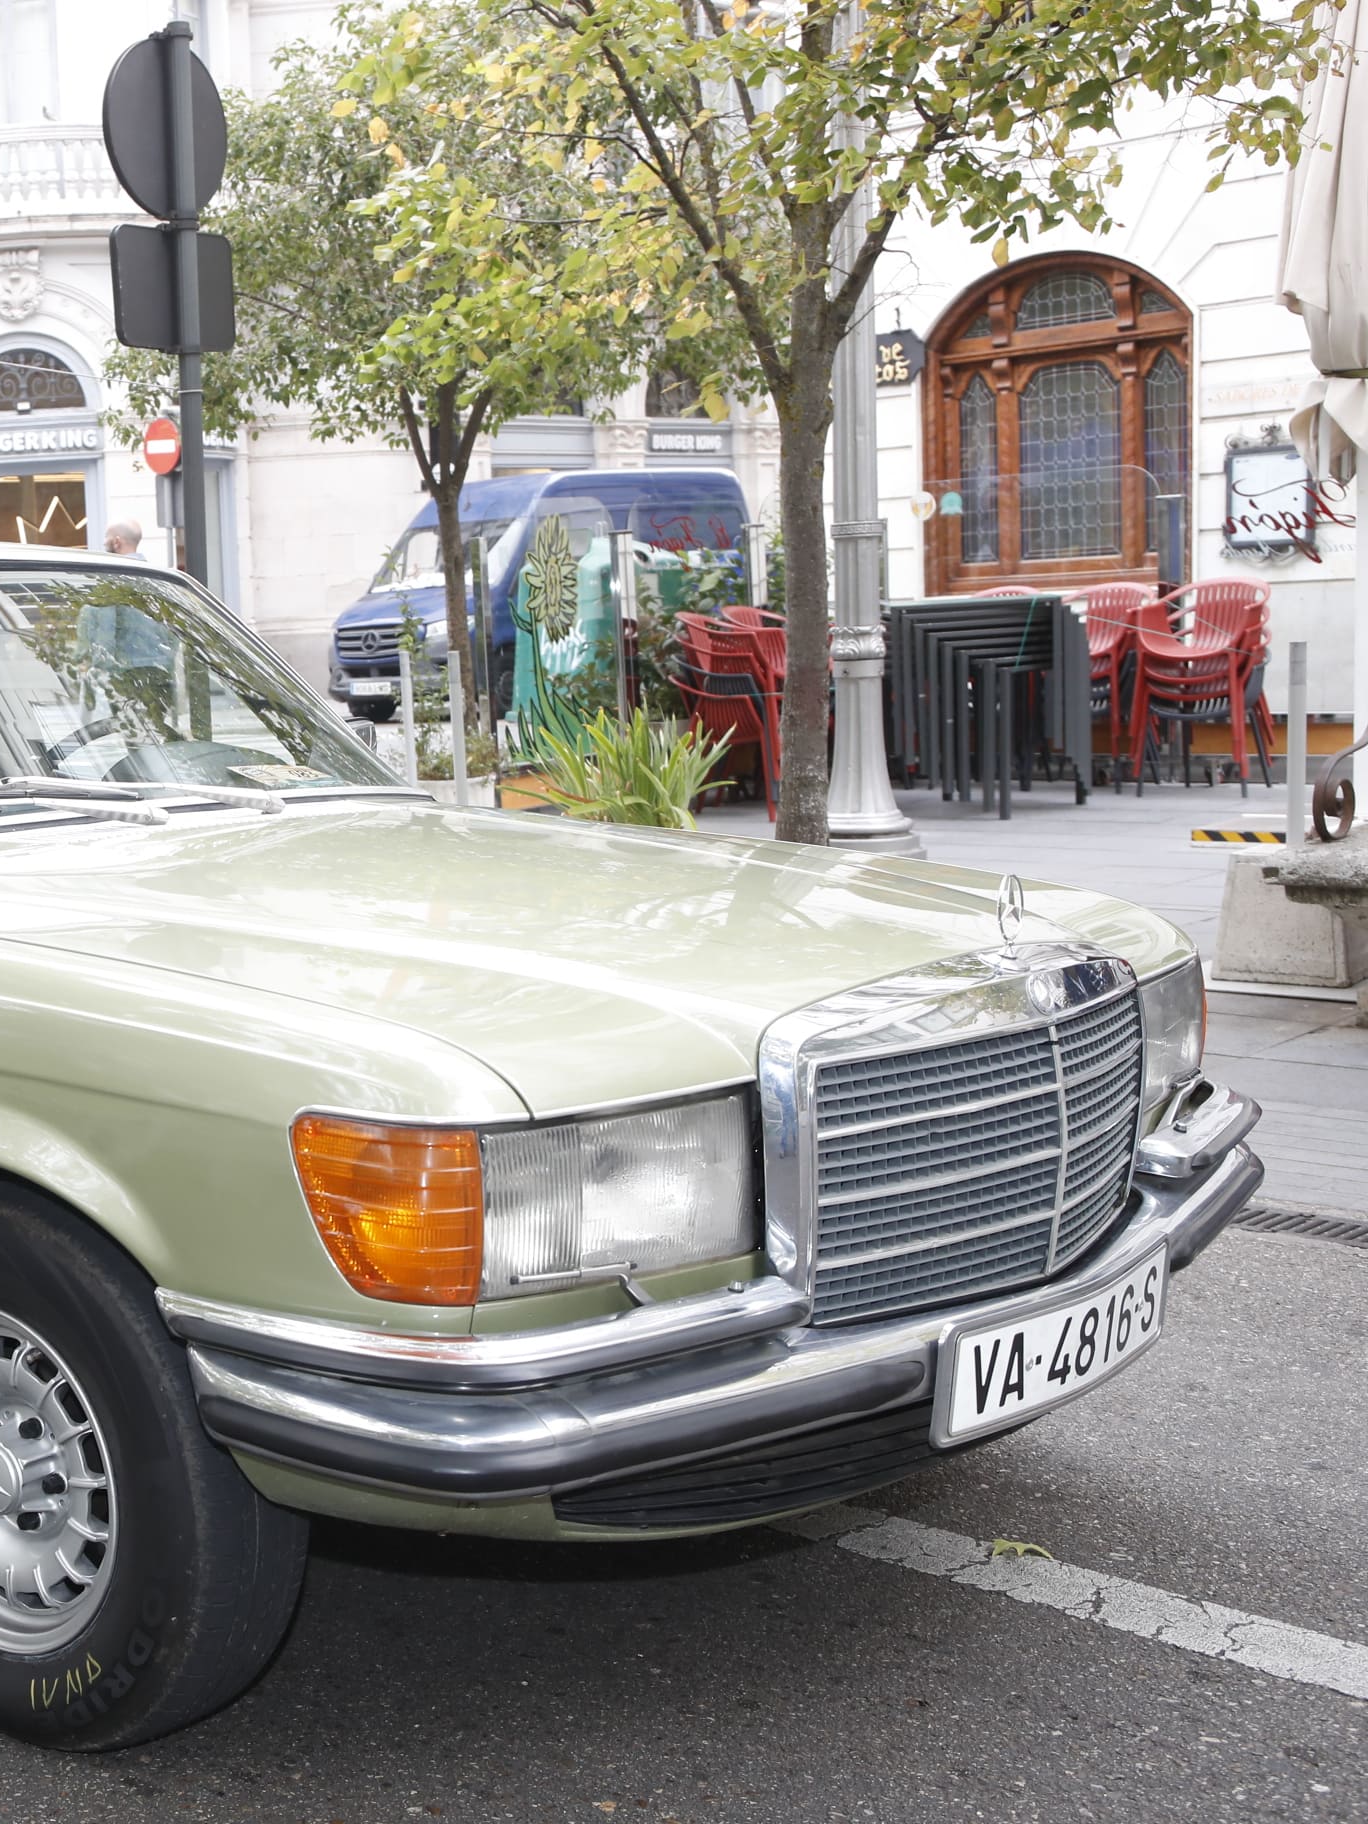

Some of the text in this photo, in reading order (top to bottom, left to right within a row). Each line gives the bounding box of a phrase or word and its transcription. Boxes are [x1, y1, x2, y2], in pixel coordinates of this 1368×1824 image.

[41, 429, 97, 451] KING
[652, 434, 722, 450] BURGER KING
